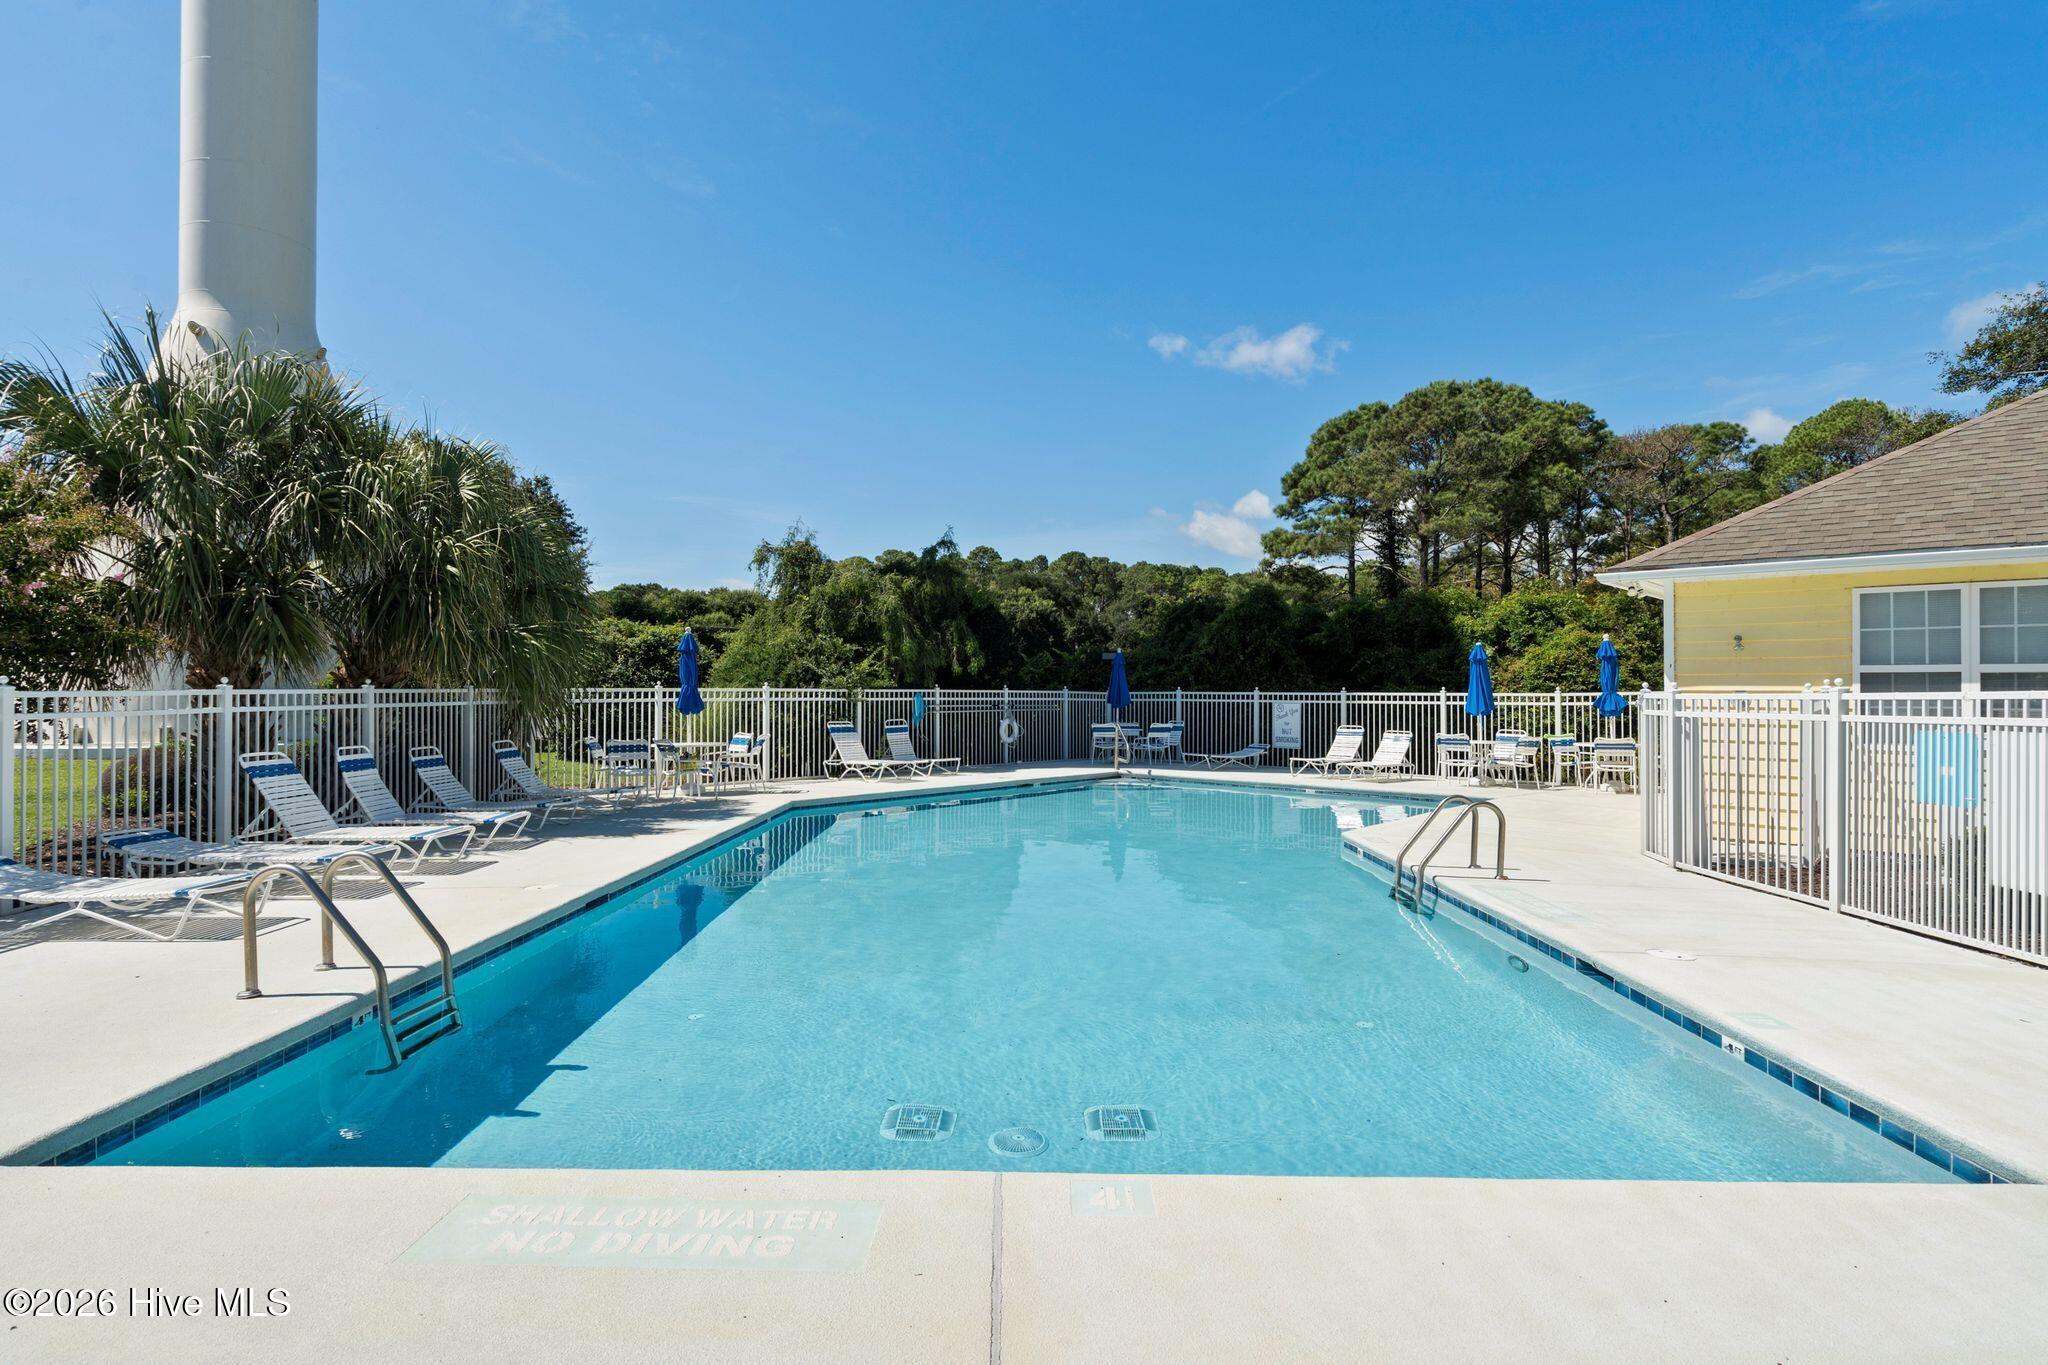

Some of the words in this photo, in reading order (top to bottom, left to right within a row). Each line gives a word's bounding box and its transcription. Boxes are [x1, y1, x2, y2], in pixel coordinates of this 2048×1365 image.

[1281, 727, 1292, 735] NOT
[480, 1203, 692, 1229] SHALLOW
[694, 1206, 840, 1231] WATER
[485, 1229, 577, 1257] NO
[588, 1231, 797, 1259] DIVING
